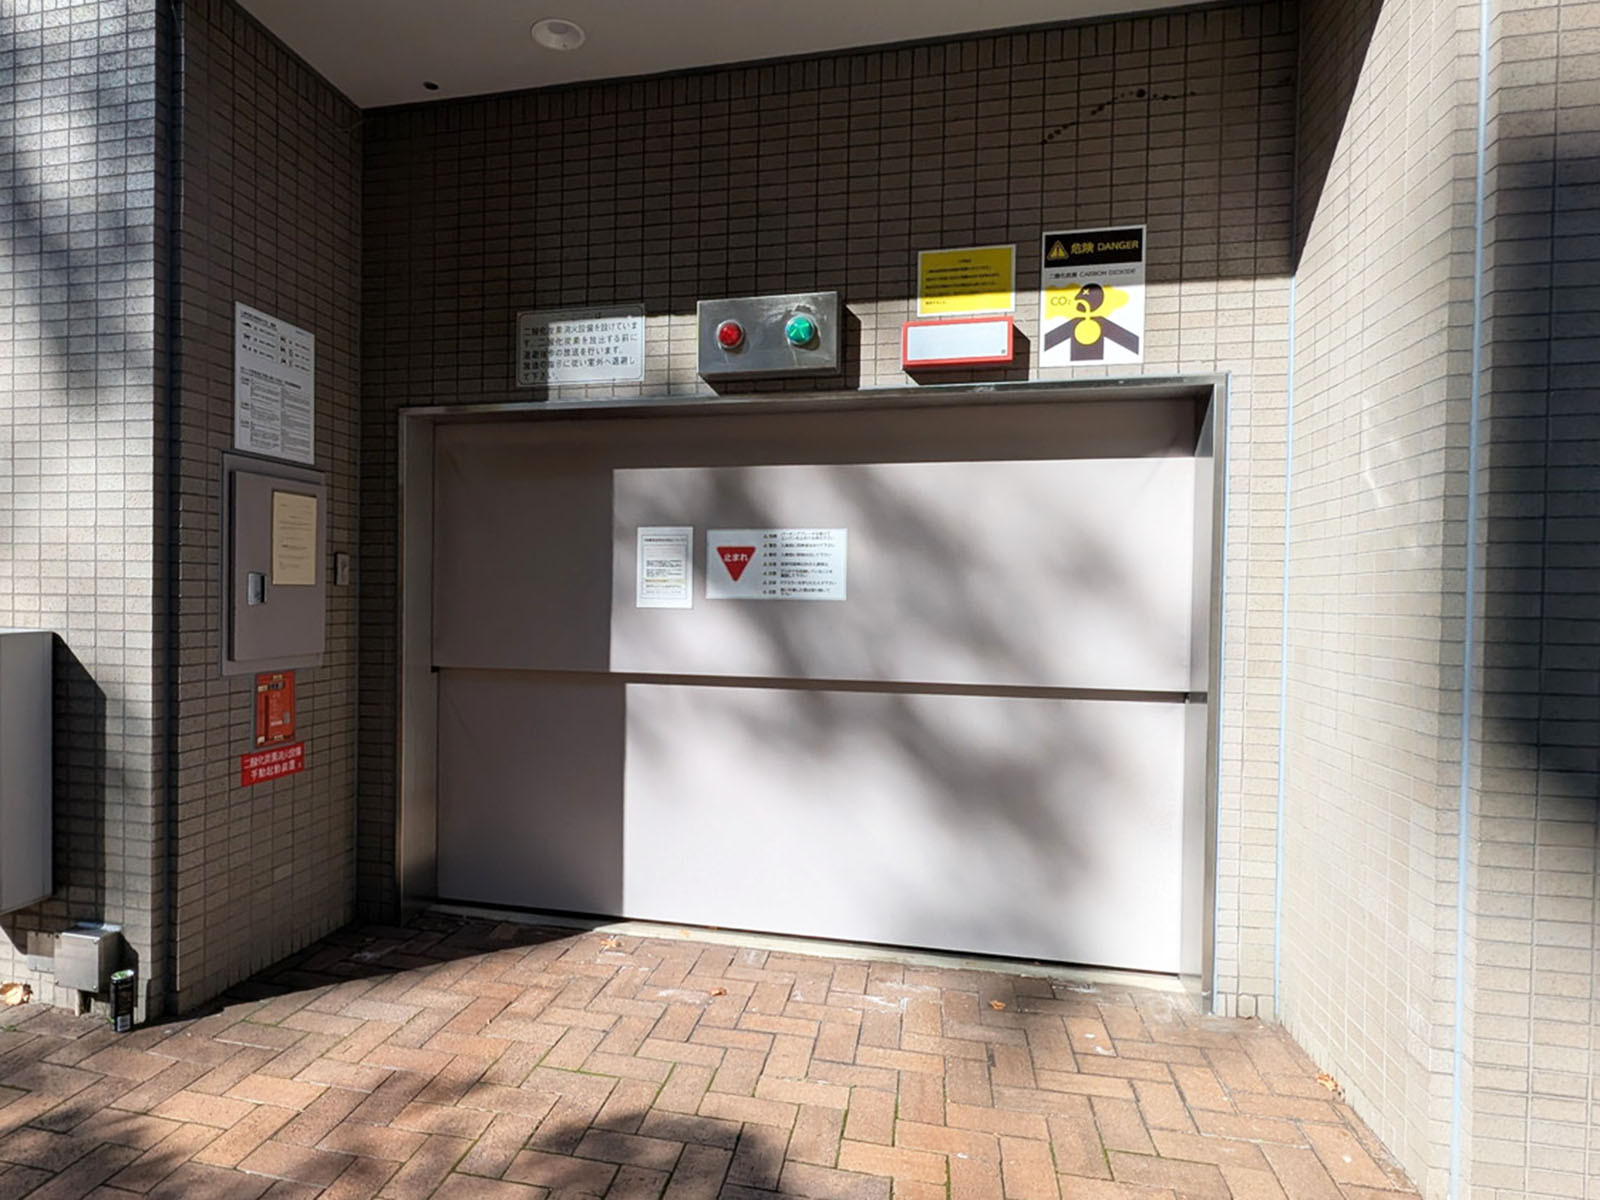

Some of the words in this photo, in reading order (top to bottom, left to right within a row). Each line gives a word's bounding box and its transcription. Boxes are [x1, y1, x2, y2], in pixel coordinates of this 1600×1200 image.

[1071, 241, 1094, 254] 危険
[1097, 239, 1139, 251] DANGER
[723, 552, 749, 562] 止まれ
